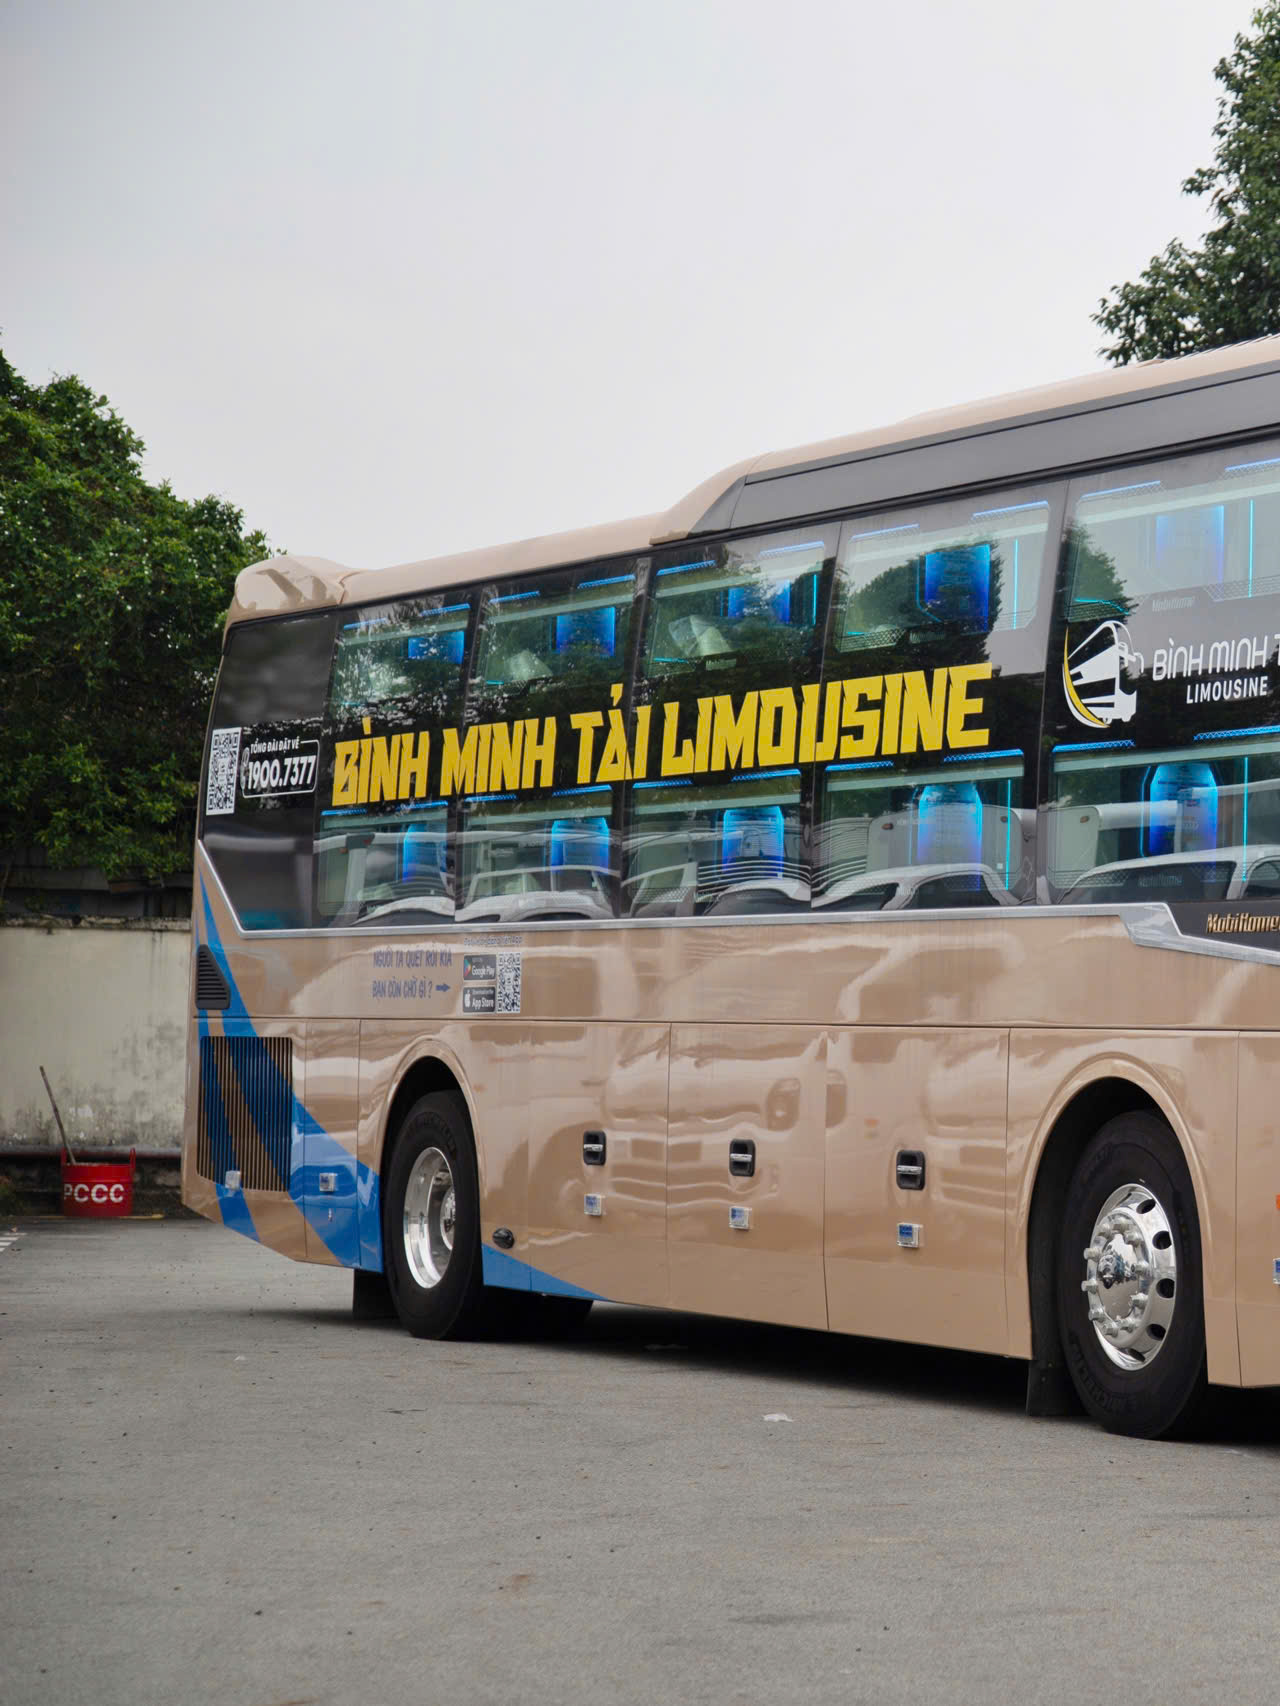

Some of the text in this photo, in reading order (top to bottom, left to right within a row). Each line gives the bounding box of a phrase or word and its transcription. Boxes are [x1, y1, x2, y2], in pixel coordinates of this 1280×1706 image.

[1152, 638, 1204, 681] BÌNH
[1209, 635, 1268, 674] MINH
[1186, 676, 1268, 704] LIMOUSINE
[332, 662, 993, 806] BÌNH MINH TẢI LIMOUSINE
[248, 755, 317, 789] 1900.7377
[395, 950, 403, 968] TA
